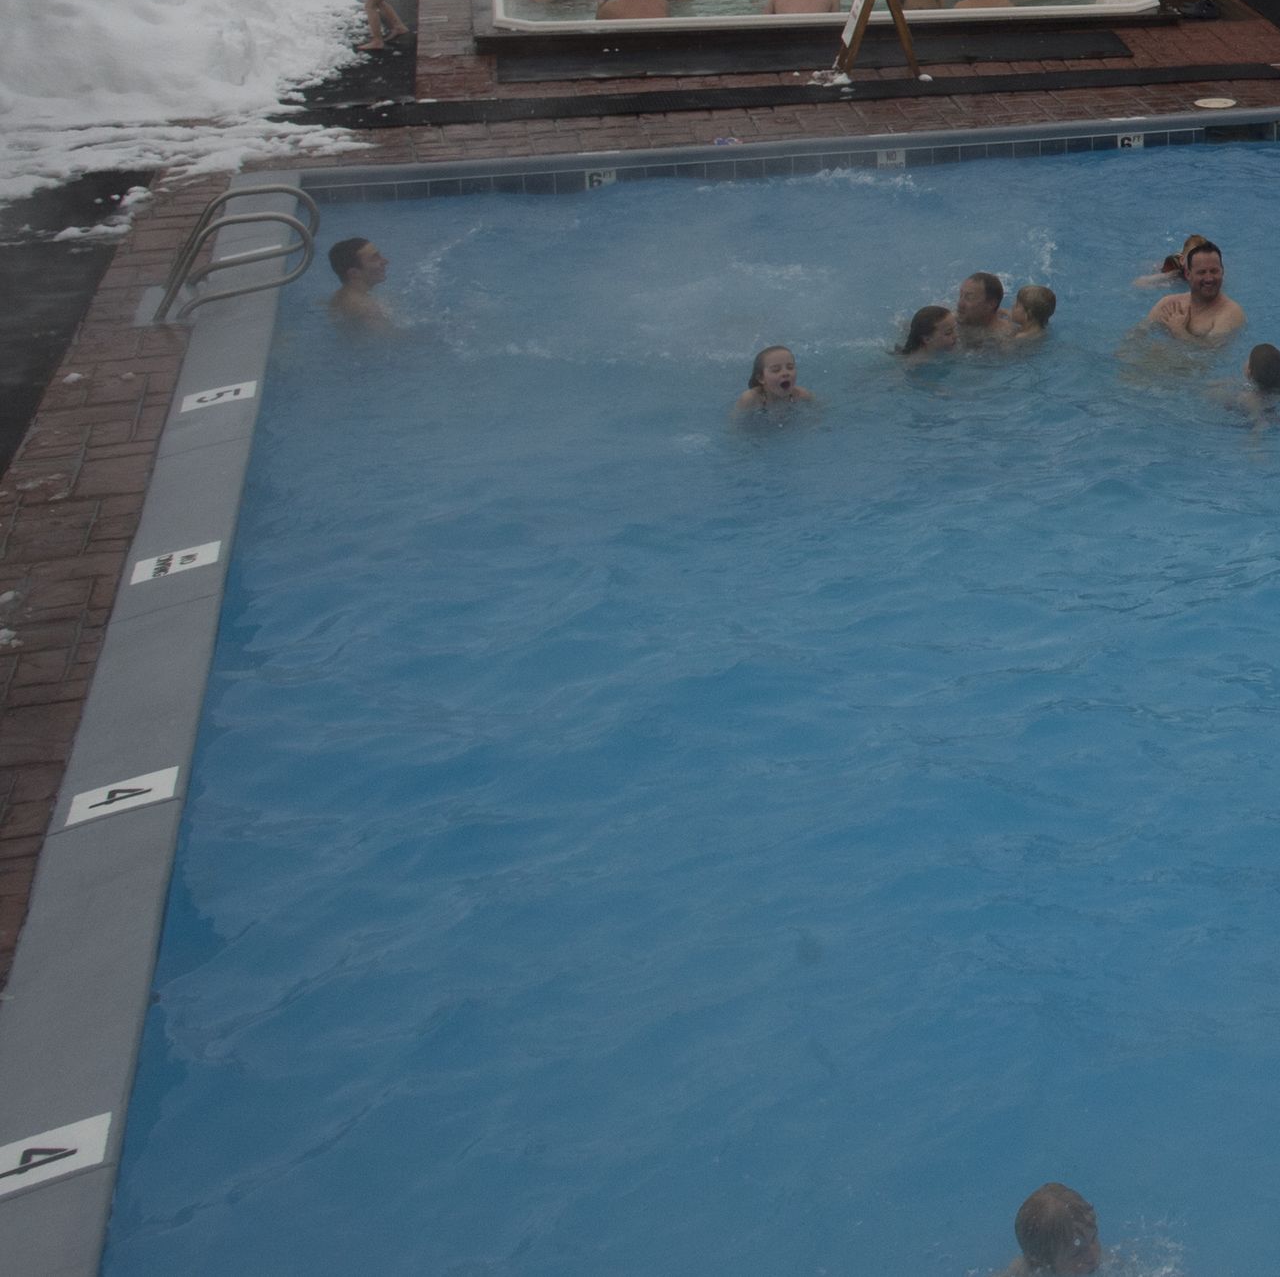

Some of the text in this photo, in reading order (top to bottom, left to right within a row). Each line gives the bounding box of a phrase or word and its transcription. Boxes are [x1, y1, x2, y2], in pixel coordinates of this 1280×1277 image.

[197, 387, 241, 404] 5
[88, 787, 153, 810] 4
[0, 1146, 78, 1179] 4
